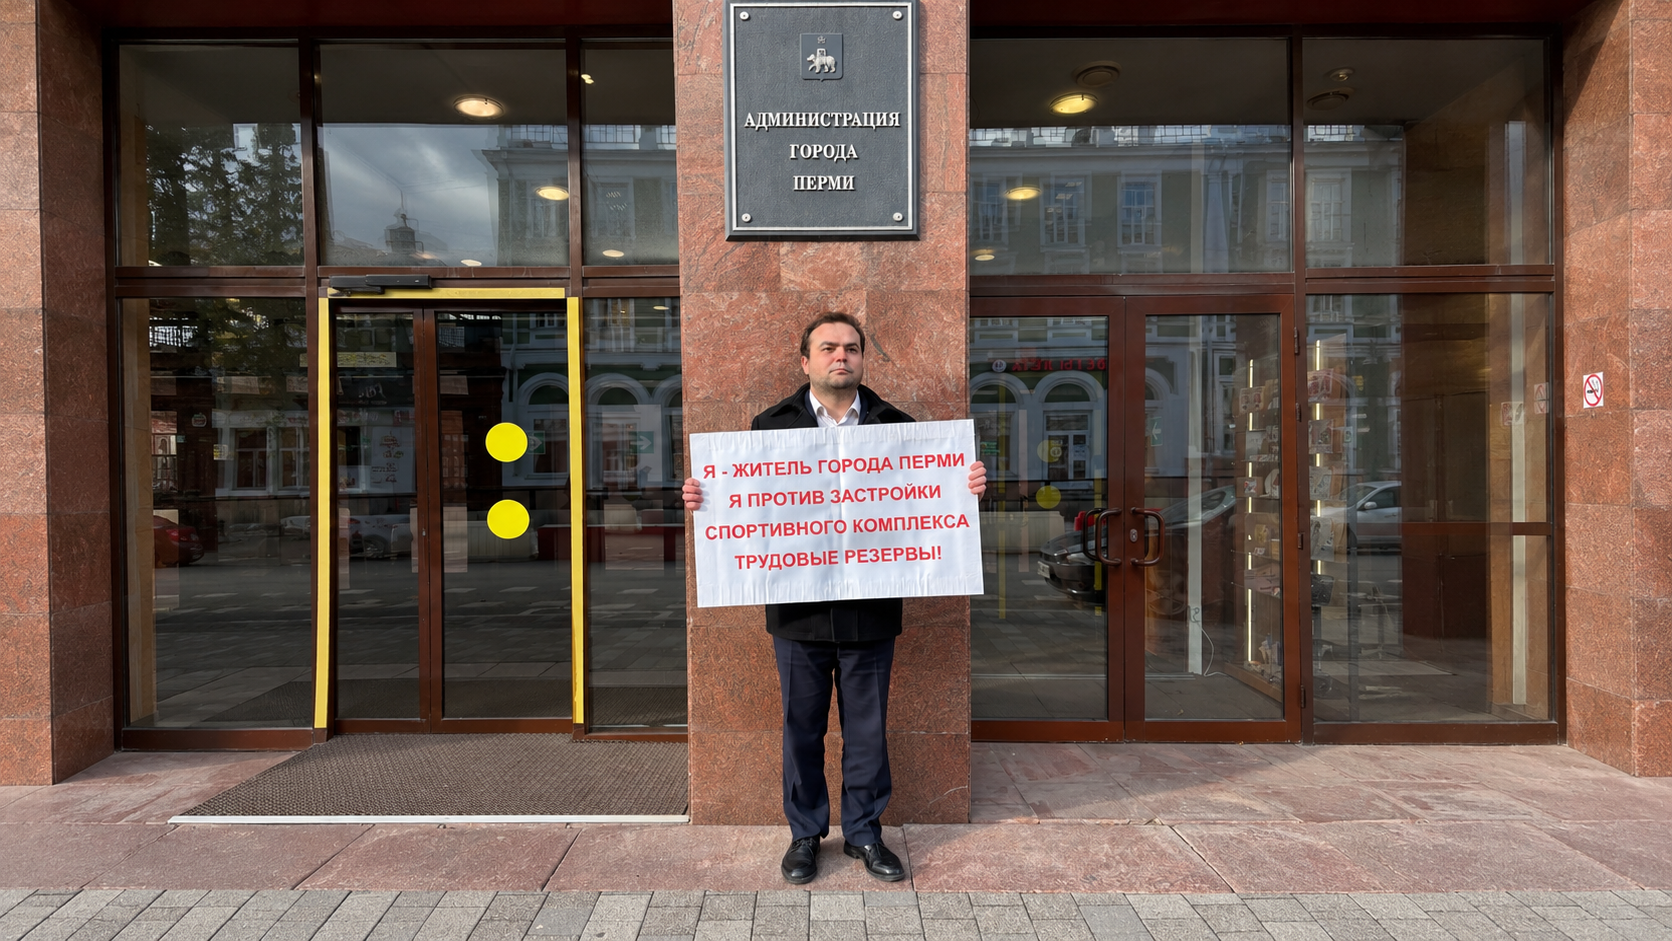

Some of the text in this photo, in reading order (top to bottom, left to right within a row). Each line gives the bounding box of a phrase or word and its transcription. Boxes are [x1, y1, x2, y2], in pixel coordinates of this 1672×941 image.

[744, 111, 901, 131] АДМИНИСТРАЦИЯ
[789, 143, 859, 162] ГОРОДА
[793, 175, 856, 191] ПЕРМИ
[703, 464, 716, 480] Я
[732, 459, 813, 478] ЖИТЕЛЬ
[817, 456, 894, 475] ГОРОДА
[898, 452, 966, 470] ПЕРМИ
[728, 483, 942, 509] Я ПРОТИВ ЗАСТРОЙКИ
[704, 513, 971, 541] СПОРТИВНОГО КОМПЛЕКСА
[734, 545, 942, 571] ТРУДОВЫЕ РЕЗЕРВЫ!
